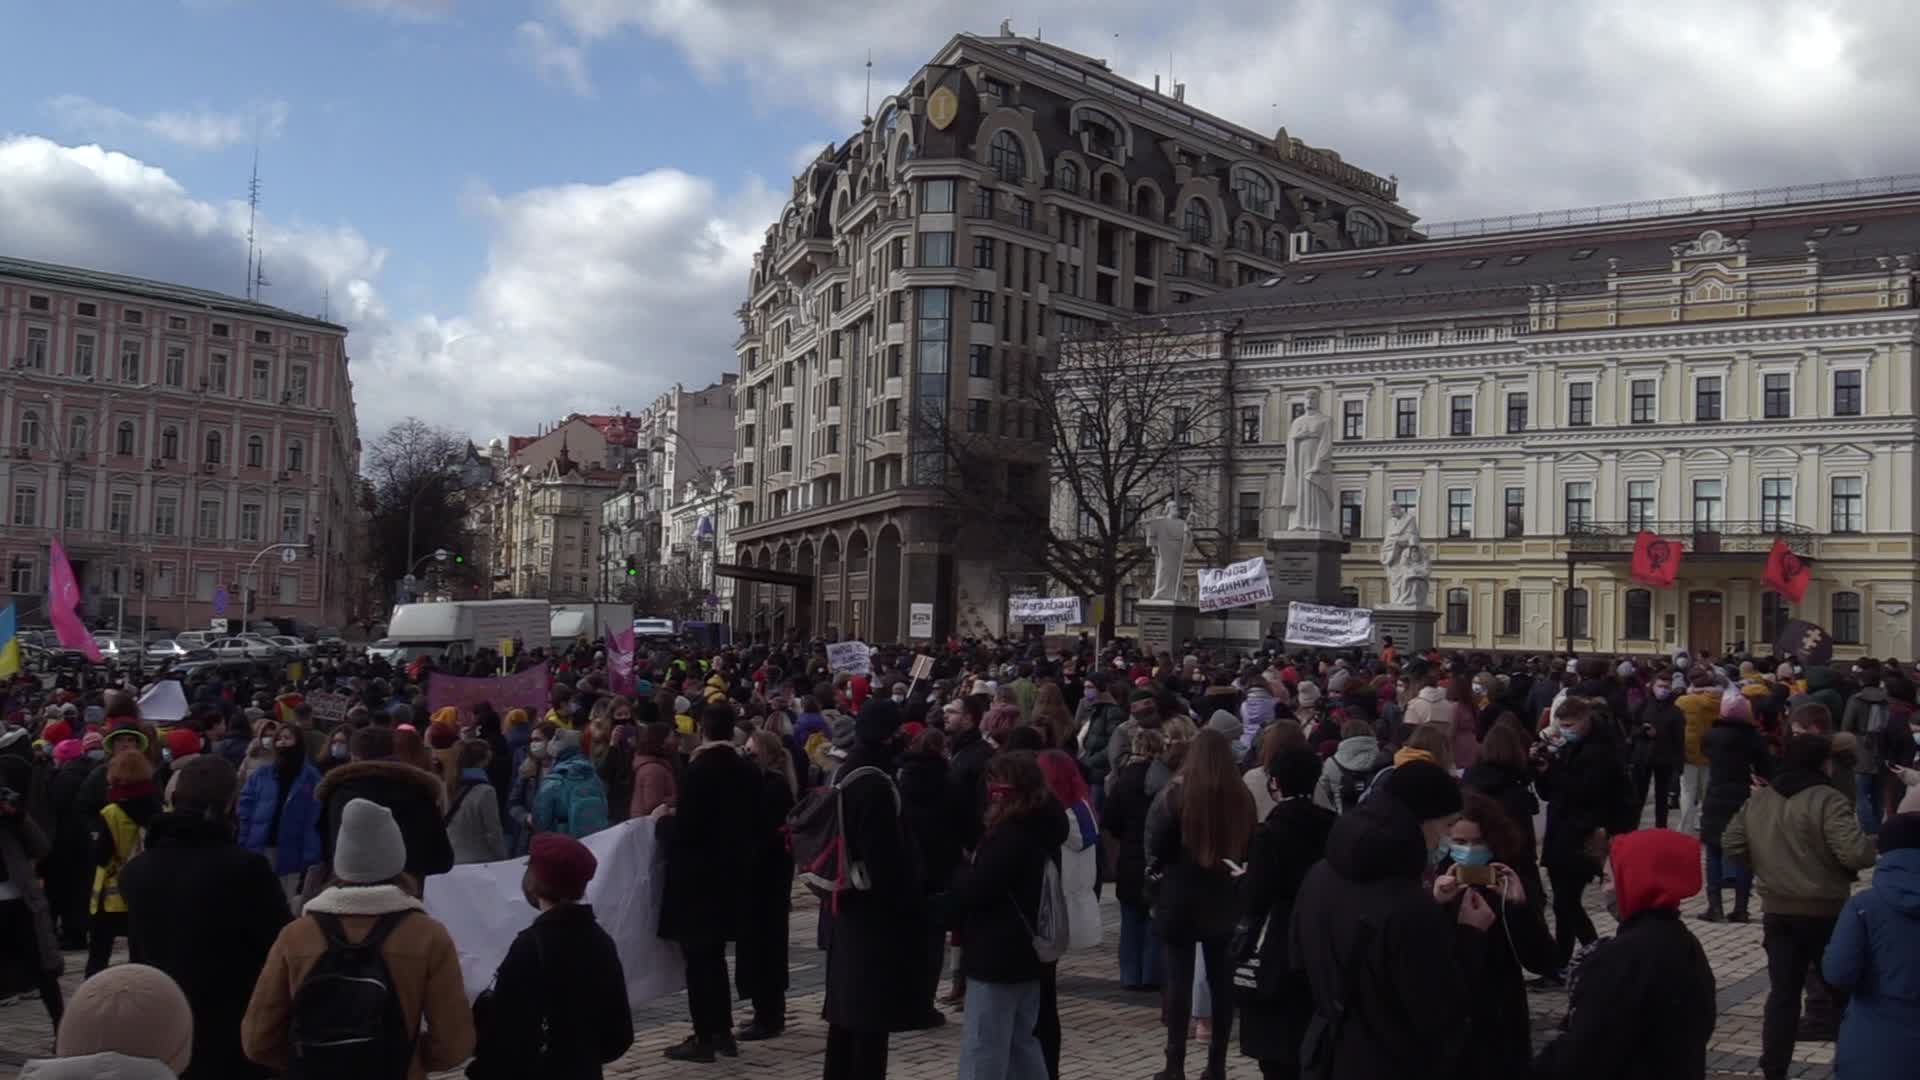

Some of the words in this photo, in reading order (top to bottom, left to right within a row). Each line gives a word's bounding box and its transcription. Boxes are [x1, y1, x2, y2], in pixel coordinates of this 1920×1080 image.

[1201, 579, 1249, 595] людини
[1200, 597, 1217, 609] від
[1218, 586, 1271, 605] зачаття!
